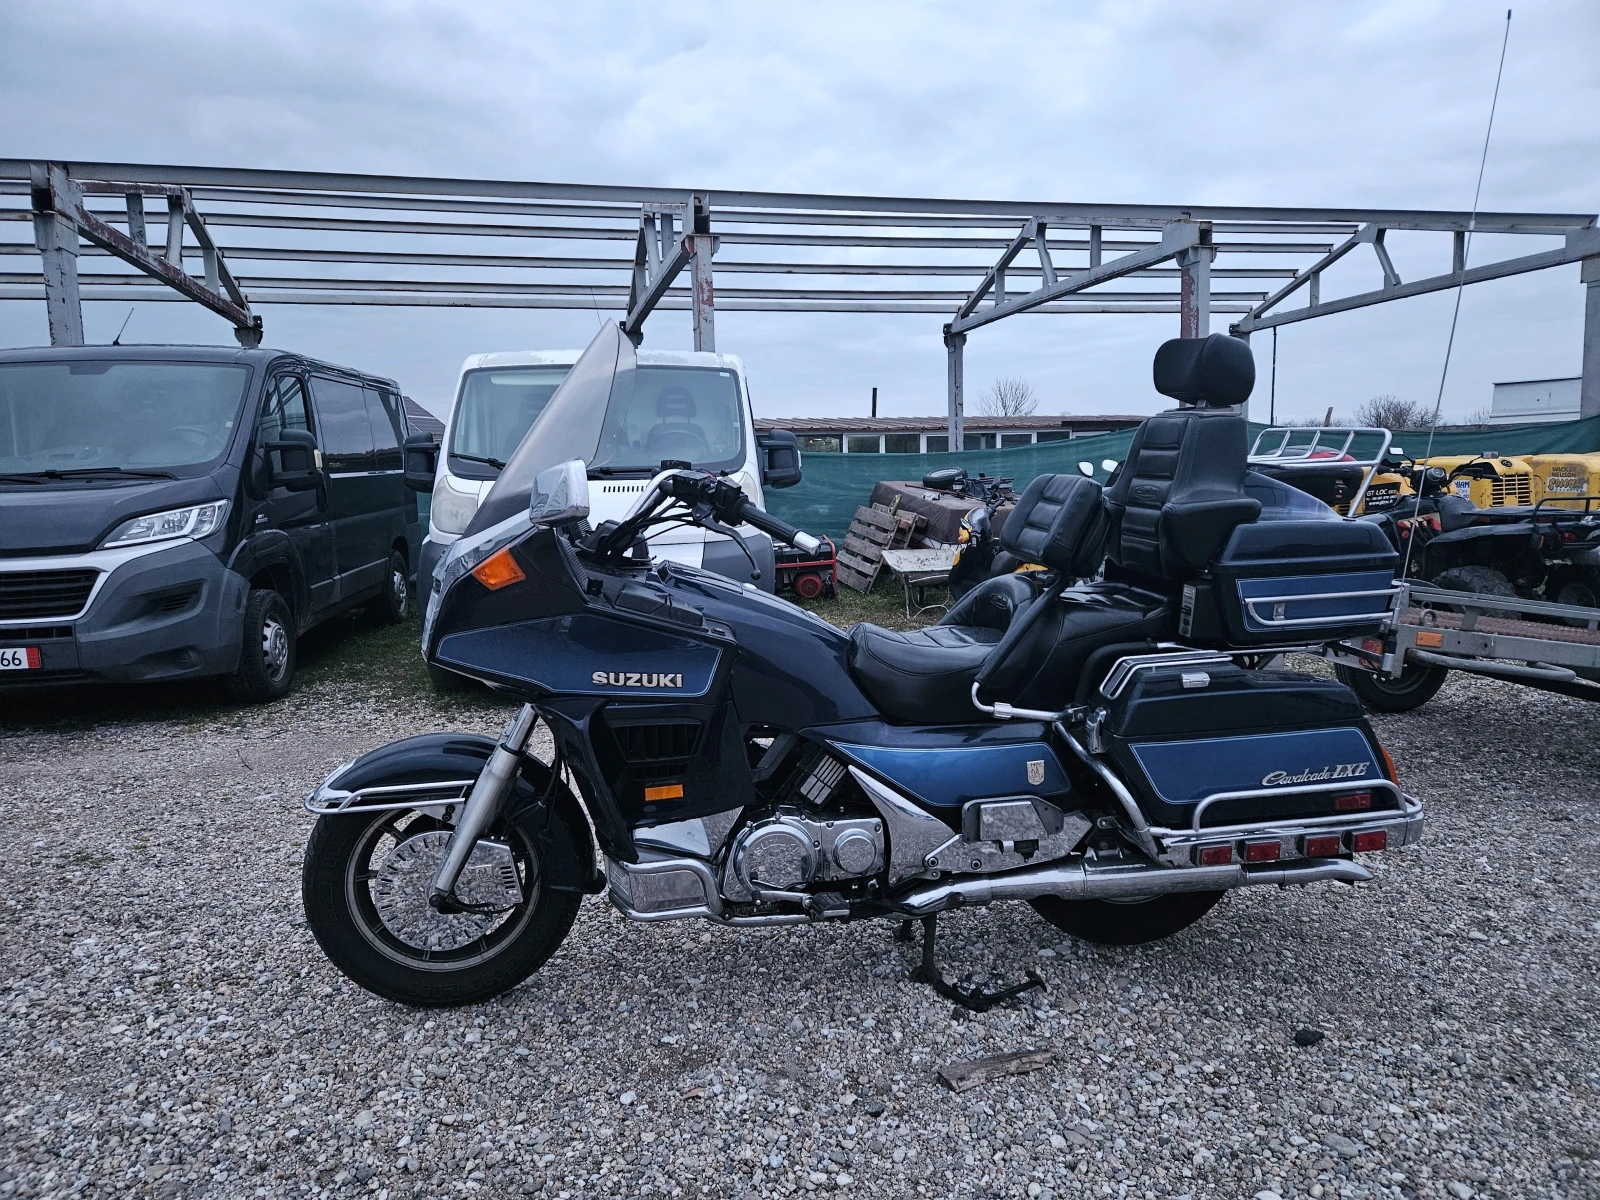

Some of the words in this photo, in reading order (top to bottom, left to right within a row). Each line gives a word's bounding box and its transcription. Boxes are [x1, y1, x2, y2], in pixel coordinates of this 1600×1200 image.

[0, 650, 22, 667] 66
[591, 671, 683, 688] SUZUKI
[1261, 766, 1331, 786] Cavalcade
[1331, 761, 1371, 779] LXE
